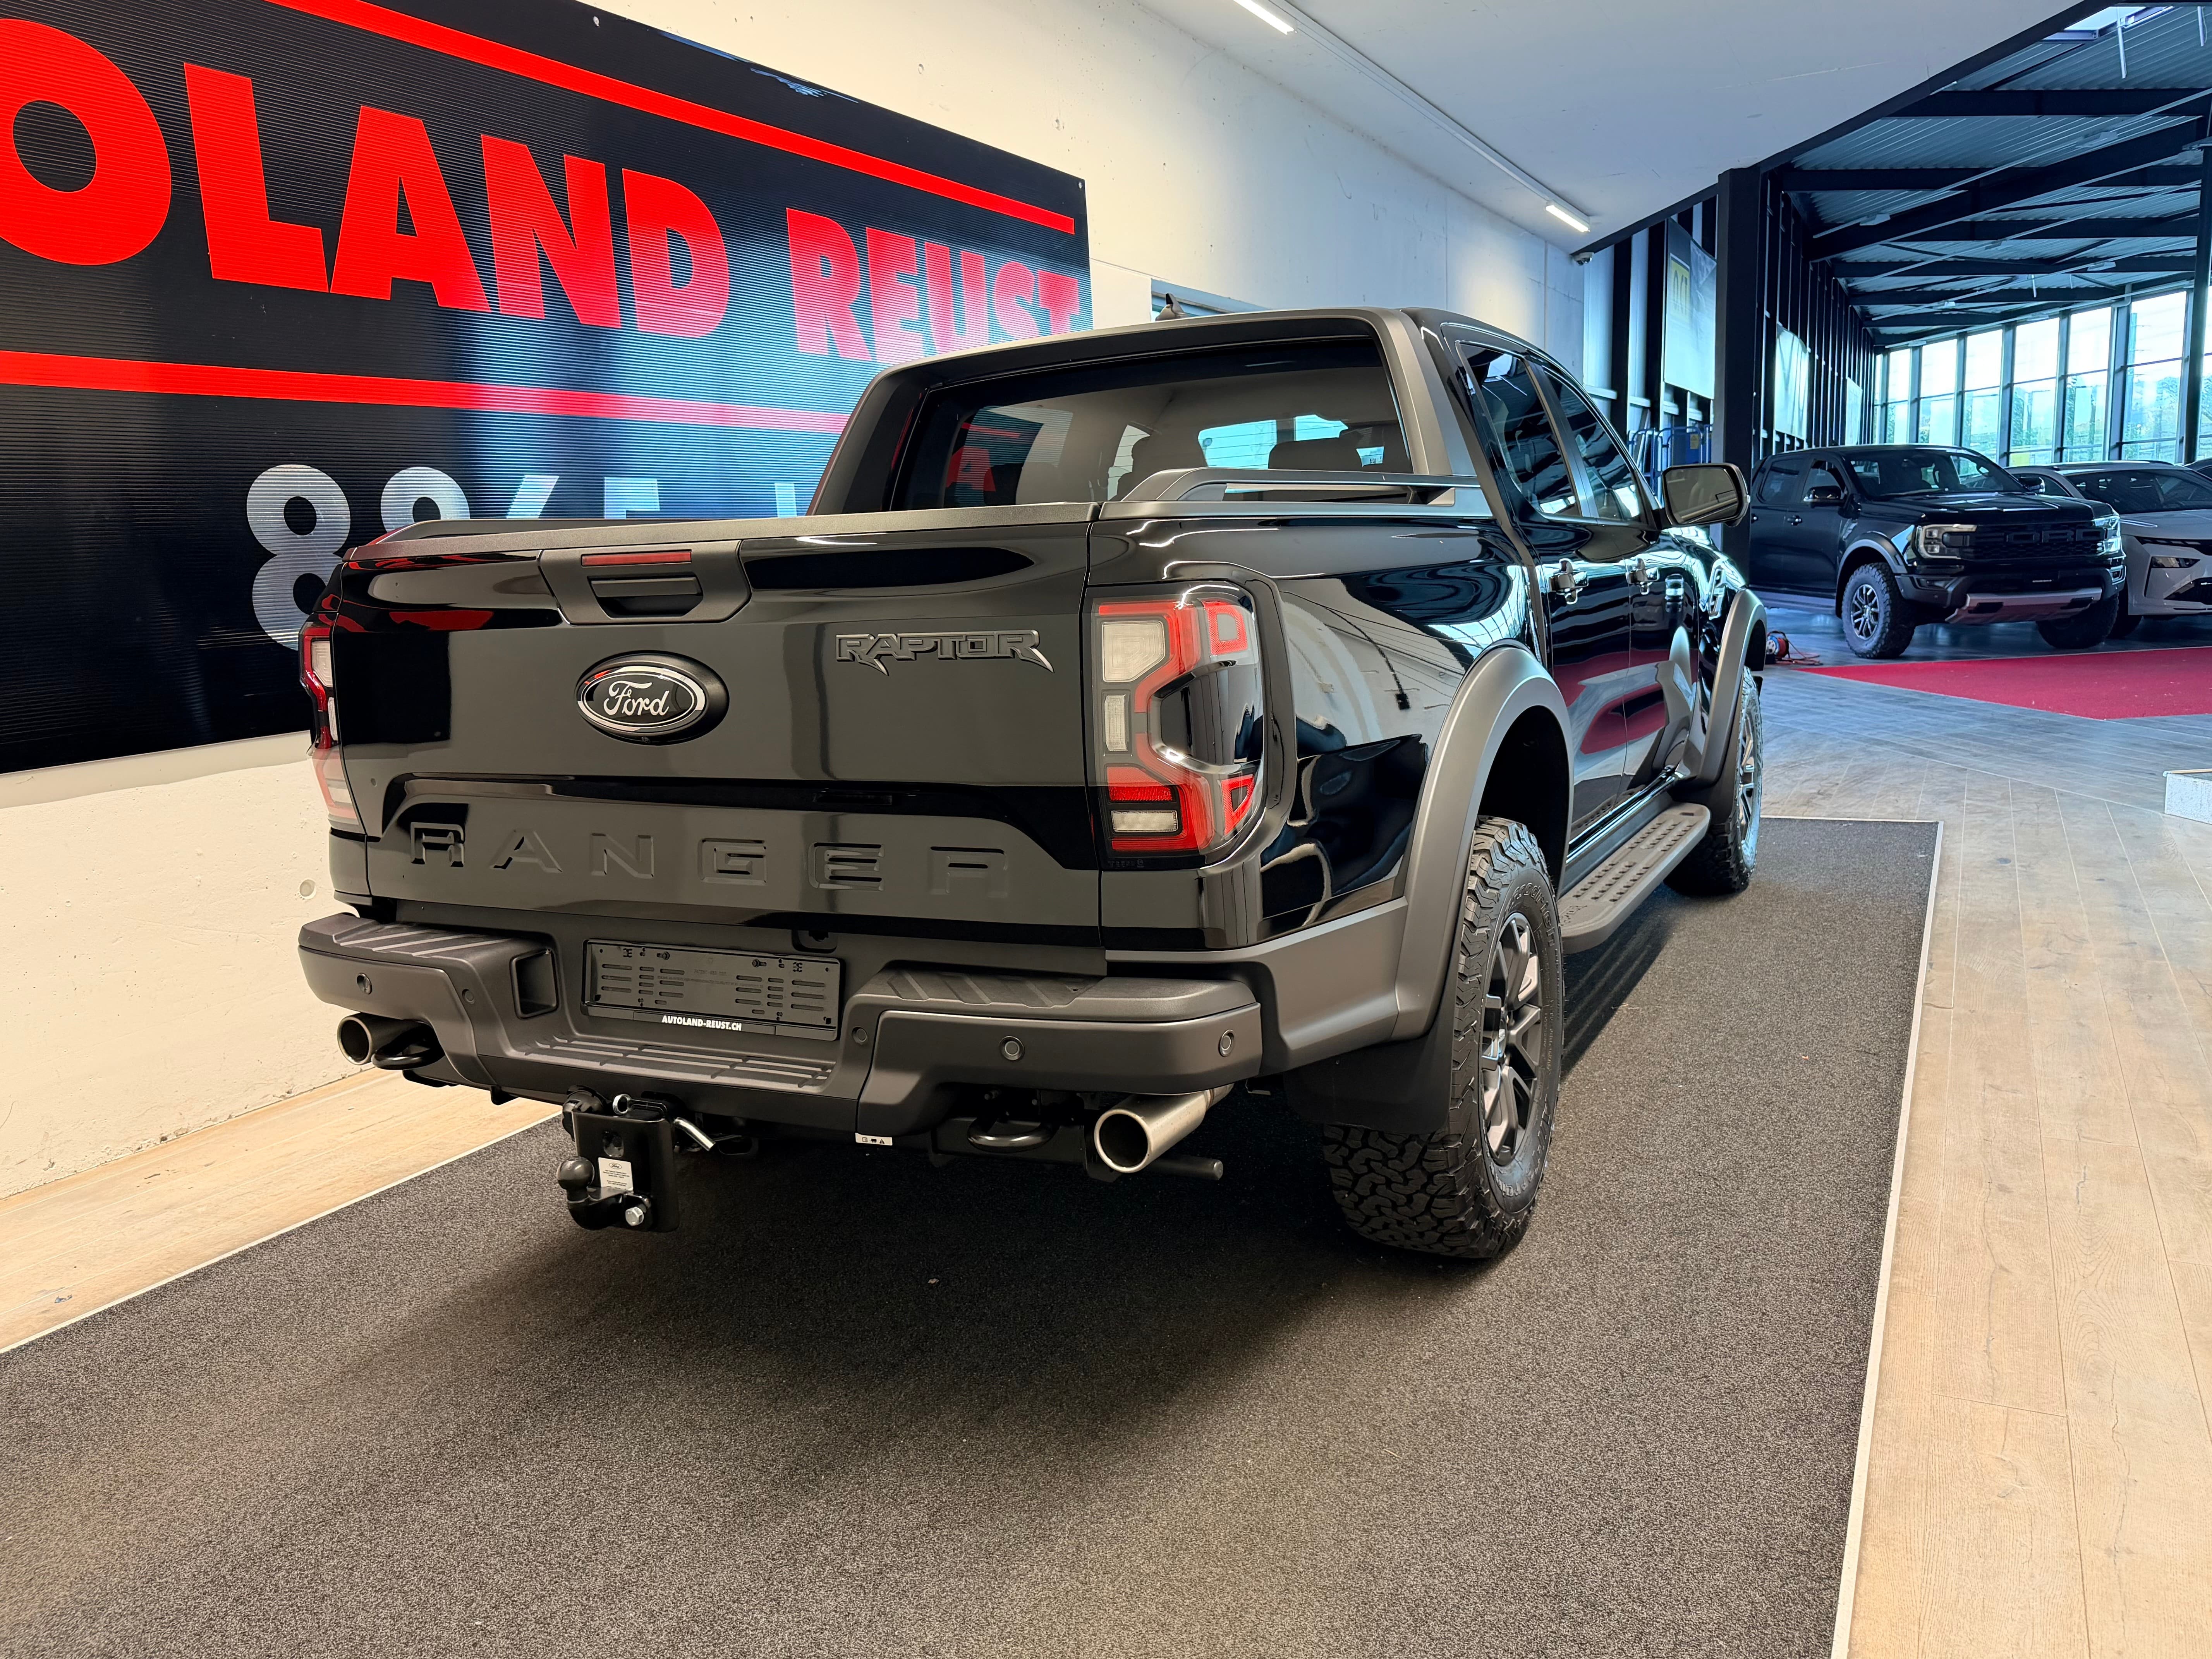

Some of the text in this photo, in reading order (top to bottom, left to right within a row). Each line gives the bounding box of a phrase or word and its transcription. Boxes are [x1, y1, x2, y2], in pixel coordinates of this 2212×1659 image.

[0, 18, 1080, 363] OLAND REUST
[836, 629, 1054, 676] RAPTOR
[603, 680, 670, 716] Ford
[410, 822, 1009, 898] RANGER
[661, 1015, 742, 1031] AUTOLAND-REUST.CH
